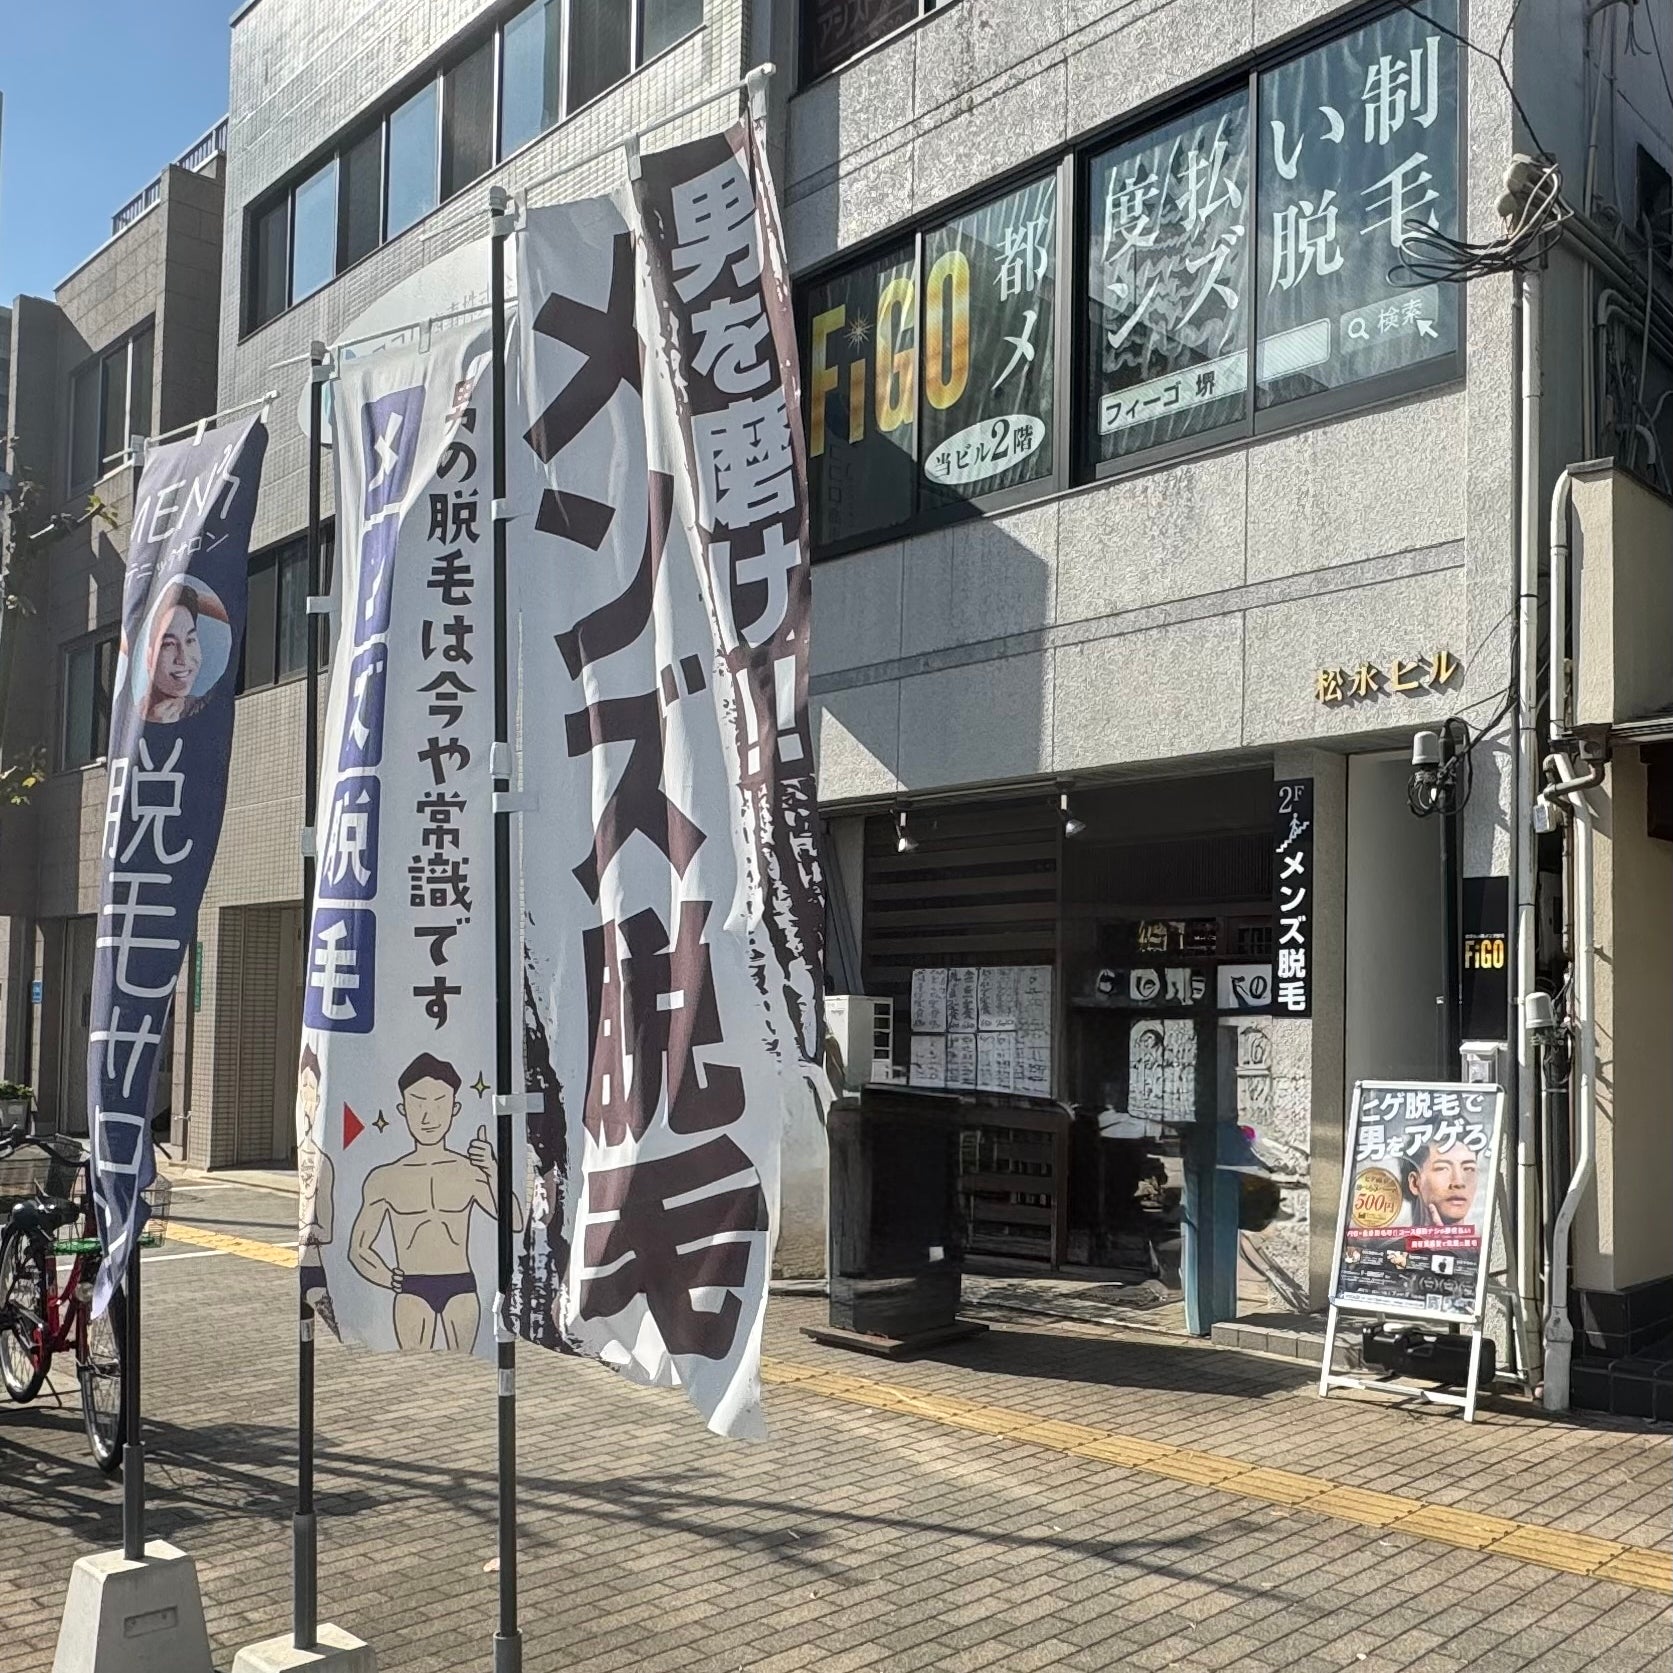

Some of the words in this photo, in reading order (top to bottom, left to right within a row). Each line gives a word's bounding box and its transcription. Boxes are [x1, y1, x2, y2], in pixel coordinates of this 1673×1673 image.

[1377, 298, 1423, 334] 検索
[1105, 379, 1181, 426] フィーゴ
[935, 418, 1034, 479] 当ビル2階
[311, 411, 403, 1020] メンズ脱毛
[522, 230, 769, 1360] メンズ脱毛
[1278, 785, 1305, 814] 2F
[1277, 851, 1307, 1011] メンズ脱毛
[1464, 939, 1504, 969] FiGO
[1355, 1193, 1395, 1213] 500円
